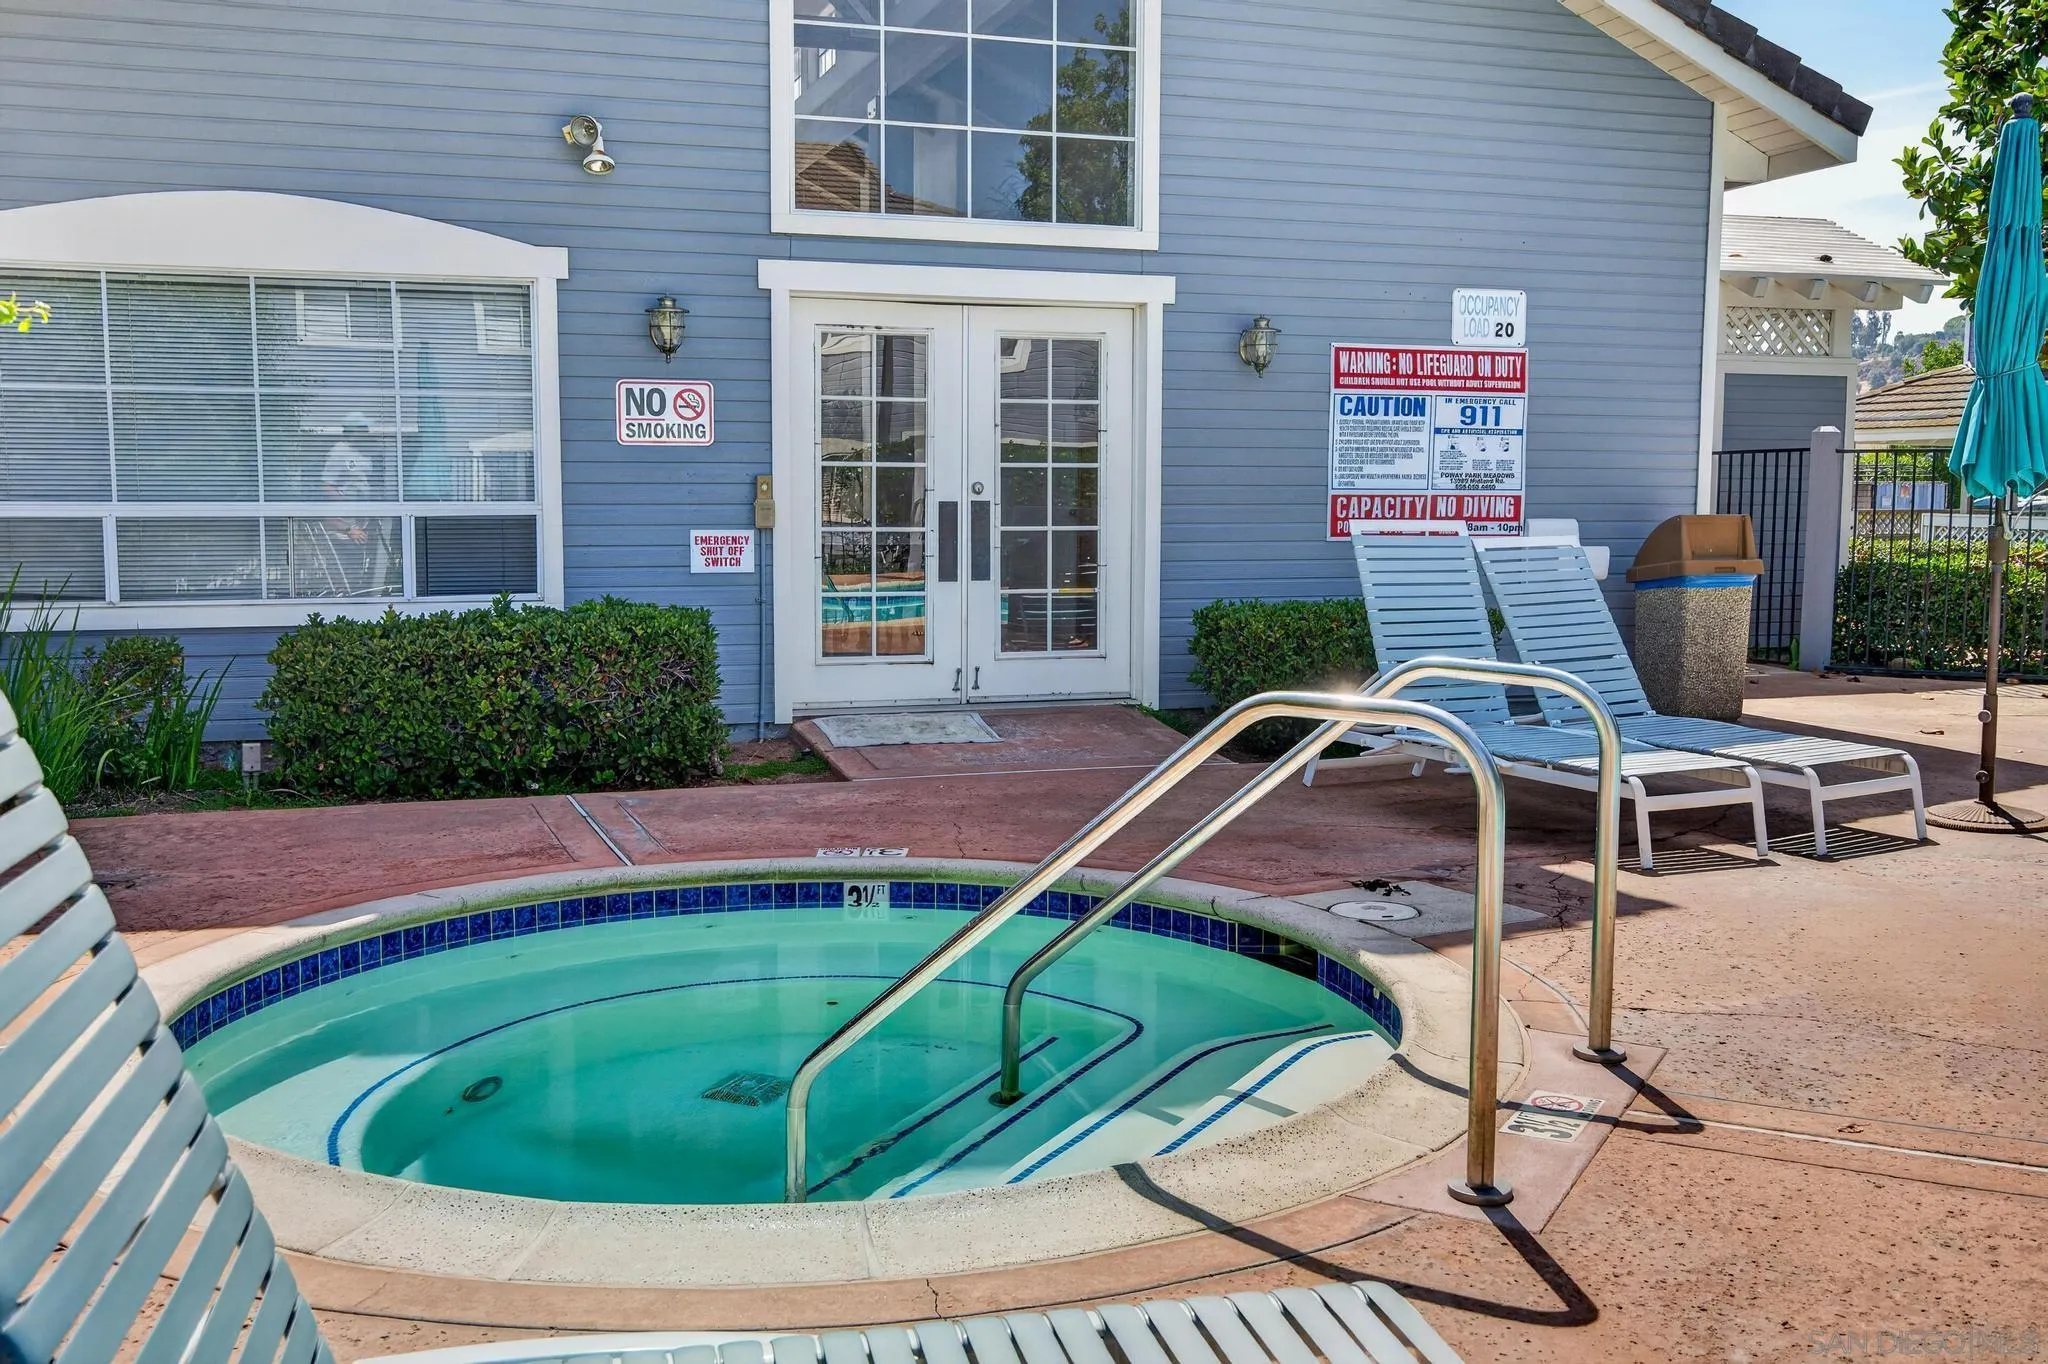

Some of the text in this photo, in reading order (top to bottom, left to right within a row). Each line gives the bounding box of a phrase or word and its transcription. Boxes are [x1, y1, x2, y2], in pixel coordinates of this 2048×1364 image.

[1459, 295, 1520, 317] OCCUPANCY
[1463, 318, 1515, 338] LOAD 20
[1398, 352, 1413, 375] NO
[1417, 353, 1474, 377] LIFEGUARD
[1477, 355, 1492, 377] ON
[1495, 355, 1522, 378] DUTY
[1339, 377, 1521, 389] CHILDREN SHOULD NOT USE POOL WITHOUT ADULT SUPERVISION
[625, 387, 667, 417] NO
[1340, 396, 1426, 417] CAUTION
[1500, 398, 1516, 406] CALL
[1460, 405, 1501, 427] 911
[625, 422, 707, 439] SMOKING
[1336, 496, 1426, 519] CAPACITY
[1436, 496, 1514, 518] NO DIVING
[1467, 523, 1488, 532] 8am
[1497, 523, 1523, 534] 10pm
[694, 535, 750, 546] EMERGENCY
[700, 546, 745, 556] SHUT OFF
[704, 557, 741, 567] SWITCH
